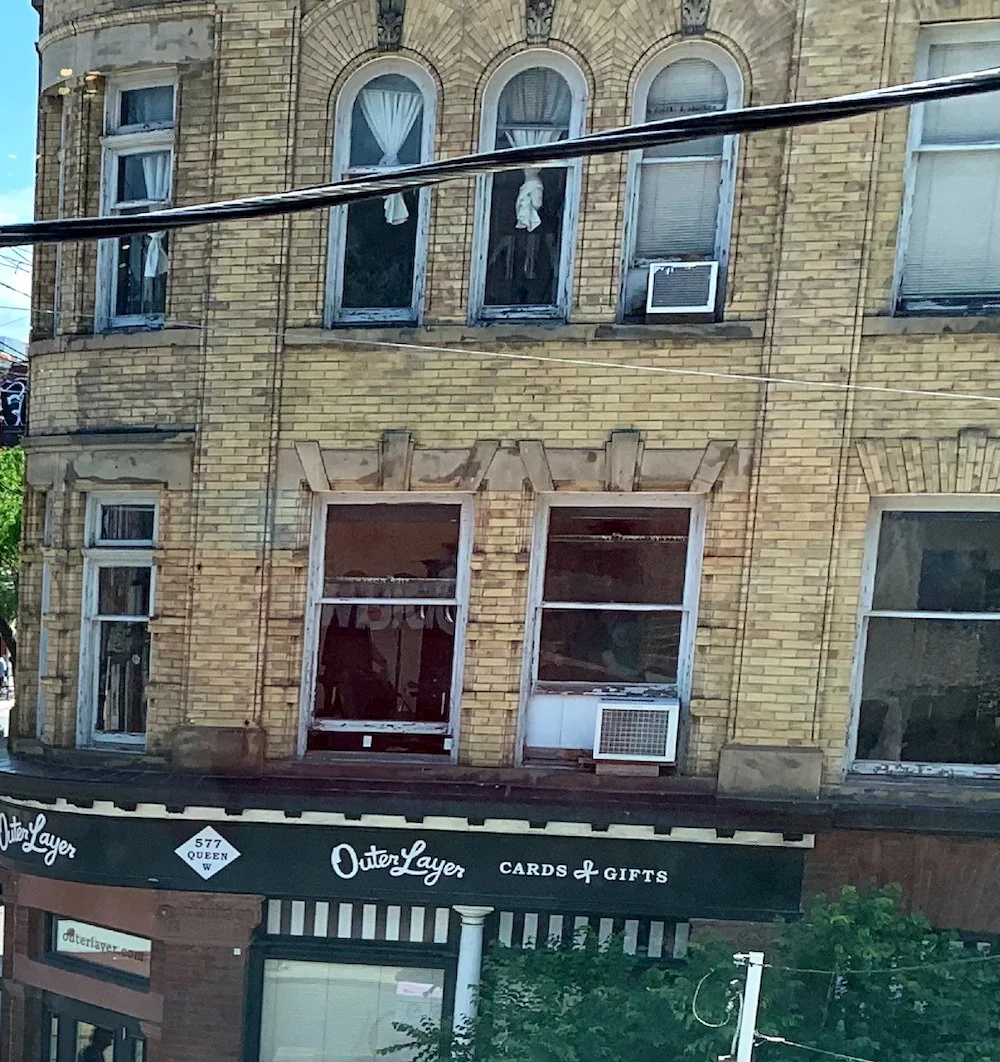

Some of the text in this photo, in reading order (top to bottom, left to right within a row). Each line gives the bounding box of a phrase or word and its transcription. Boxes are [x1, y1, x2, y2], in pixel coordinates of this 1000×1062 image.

[194, 838, 222, 849] 577
[187, 850, 229, 861] QUEEN
[202, 862, 212, 872] W
[499, 860, 568, 878] CARDS
[604, 866, 669, 884] GIFTS
[62, 930, 145, 962] outerlayer.com
